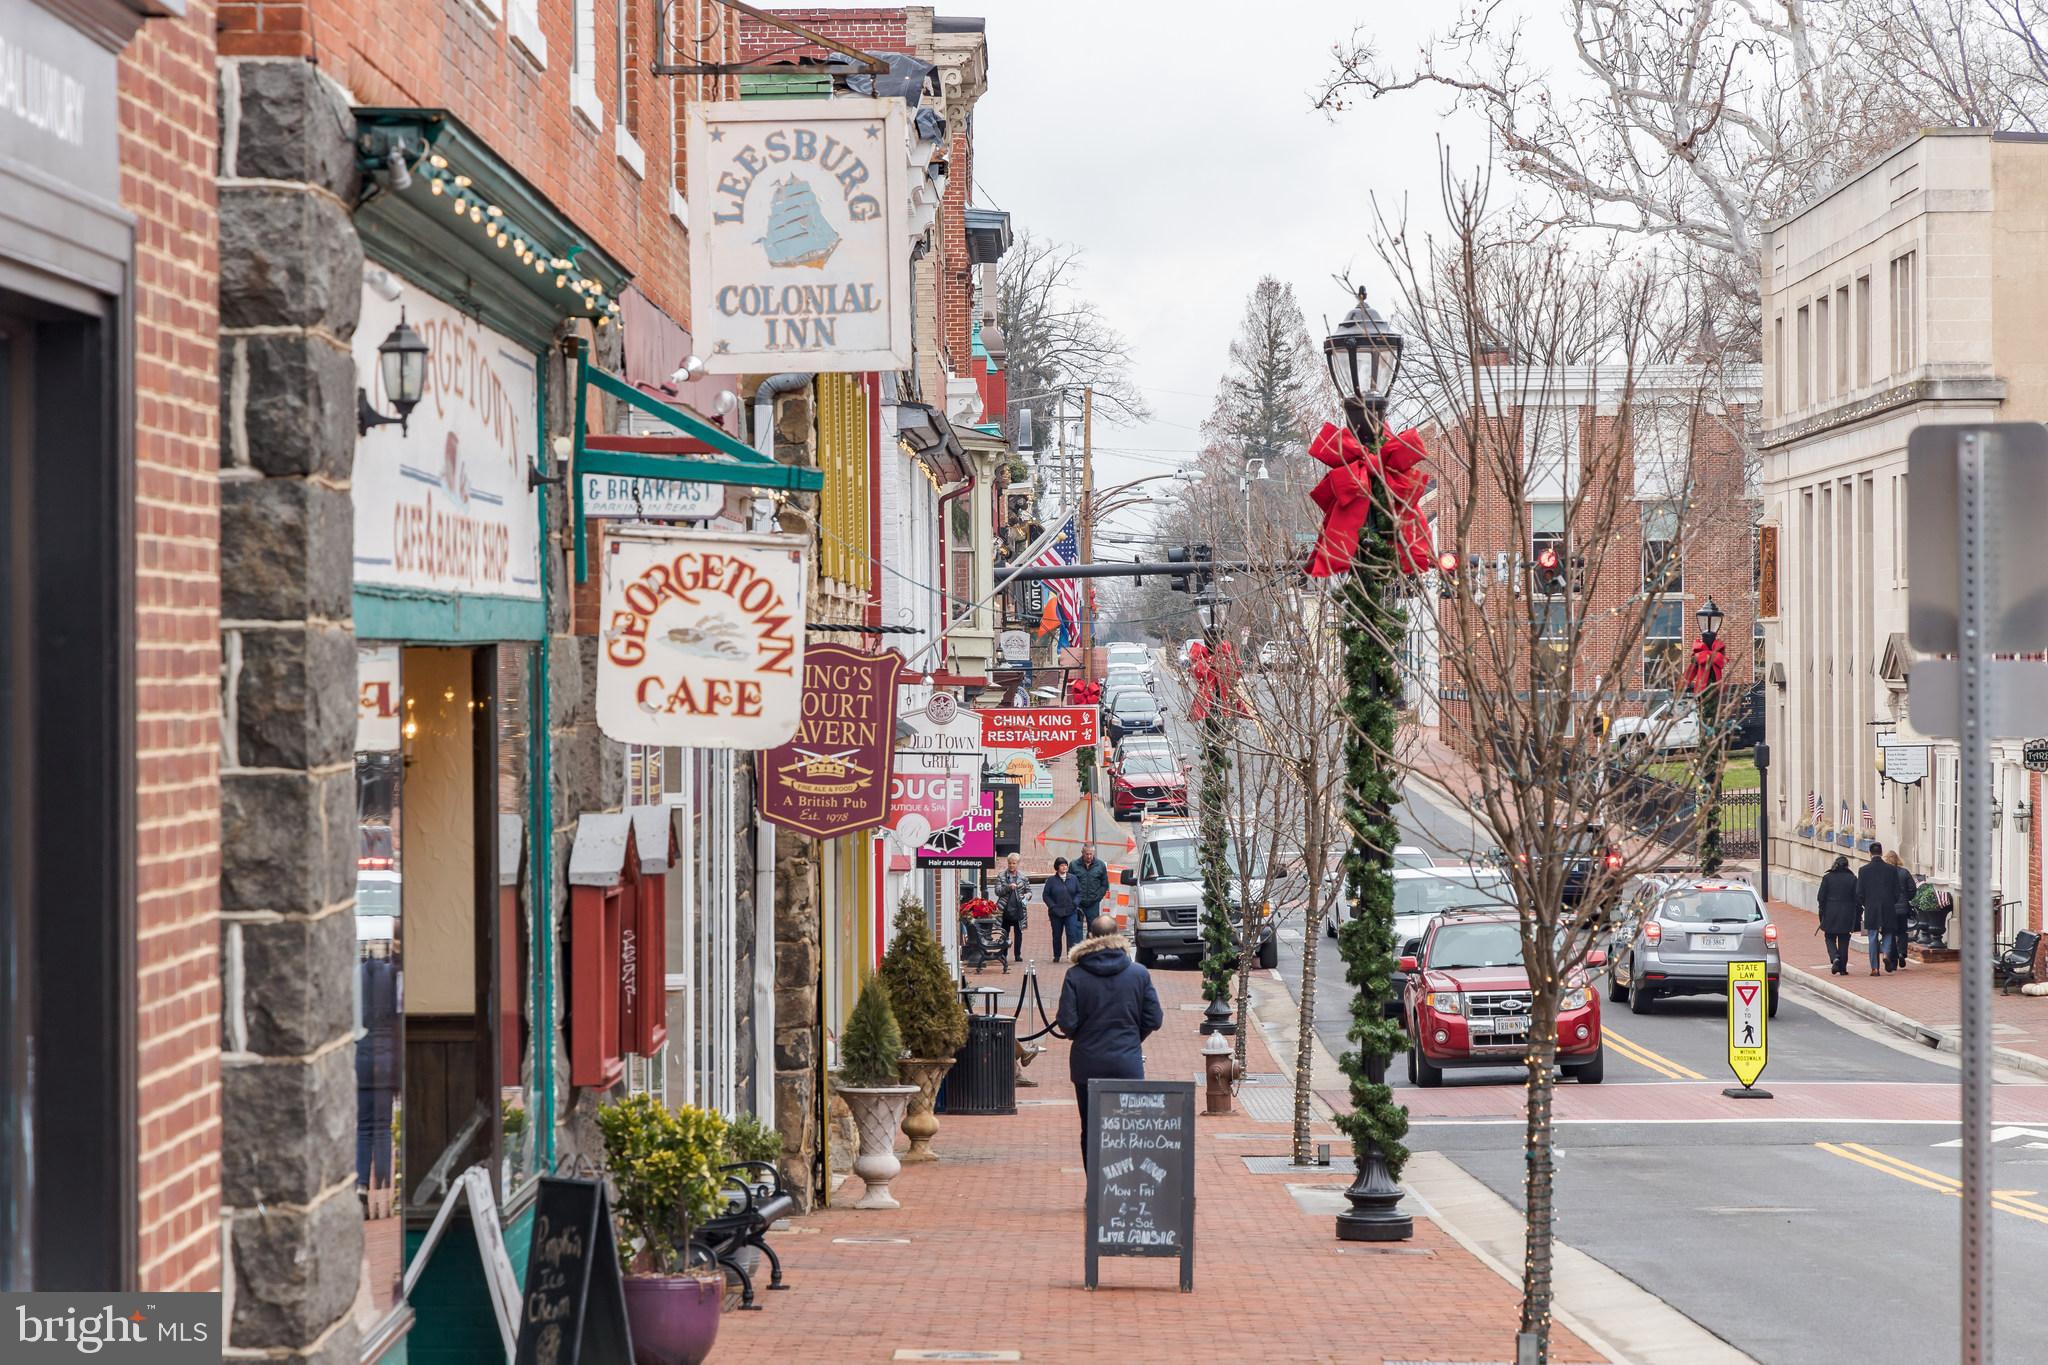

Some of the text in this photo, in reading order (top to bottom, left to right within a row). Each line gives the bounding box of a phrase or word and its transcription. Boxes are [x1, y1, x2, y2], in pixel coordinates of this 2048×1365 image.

[714, 127, 882, 226] LEESBURG
[717, 283, 882, 317] COLONIAL
[765, 317, 838, 350] INN
[589, 478, 601, 500] &
[437, 510, 480, 588] BAKERY
[482, 520, 509, 586] SHOP
[606, 552, 795, 677] GEORGETOWN
[803, 664, 872, 691] ING'S
[636, 676, 763, 717] CAFE
[802, 692, 873, 718] OURT
[993, 714, 1072, 727] CHINA KING
[791, 720, 877, 746] AVERN
[935, 733, 975, 750] TOWN
[987, 730, 1078, 742] RESTAURANT
[921, 754, 959, 769] GRILL
[891, 779, 964, 800] OUGE
[783, 796, 867, 809] A British Pub
[800, 808, 849, 822] Est. 1978
[967, 816, 992, 832] Lee
[928, 859, 982, 869] Hair and Makeup
[1102, 1117, 1120, 1130] 365
